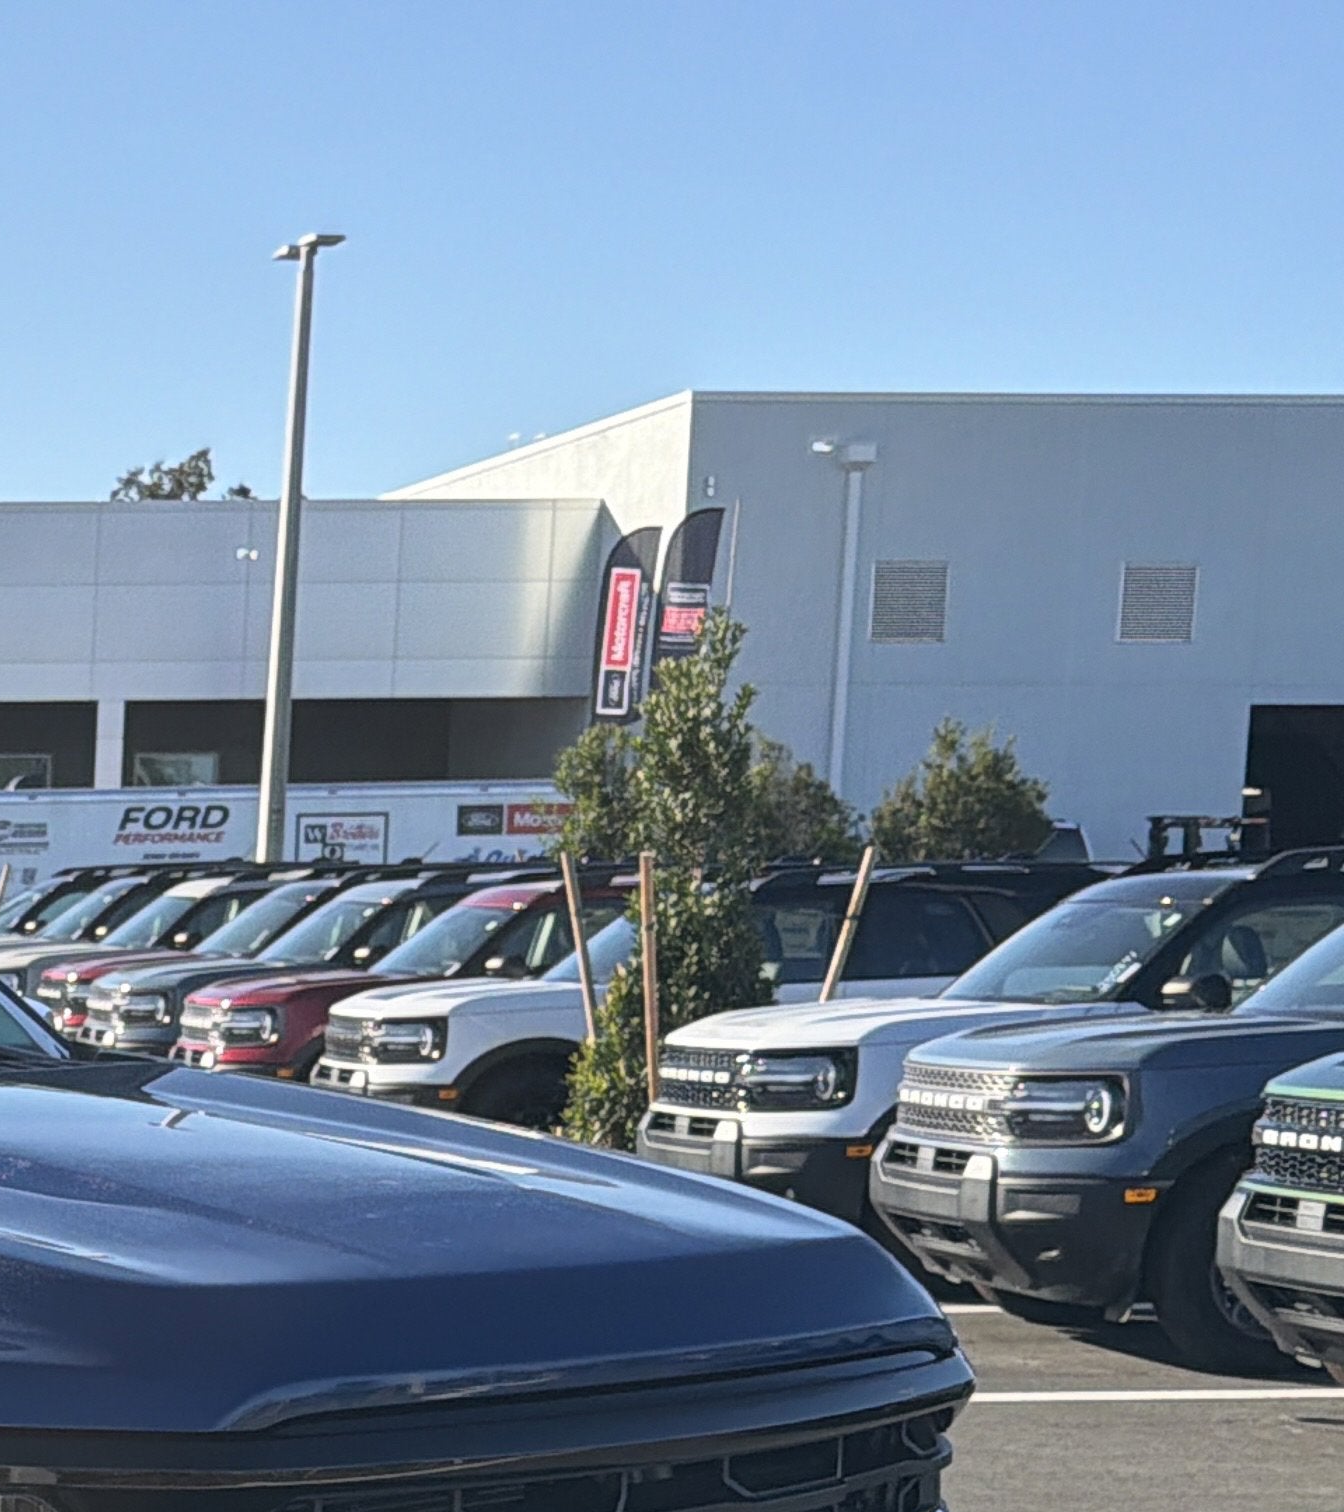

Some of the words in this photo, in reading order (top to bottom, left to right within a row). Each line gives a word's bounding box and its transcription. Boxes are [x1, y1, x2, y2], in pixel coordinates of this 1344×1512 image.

[118, 805, 230, 831] FORD
[113, 831, 225, 845] PERFORMANCE
[900, 1088, 984, 1110] BRONCO
